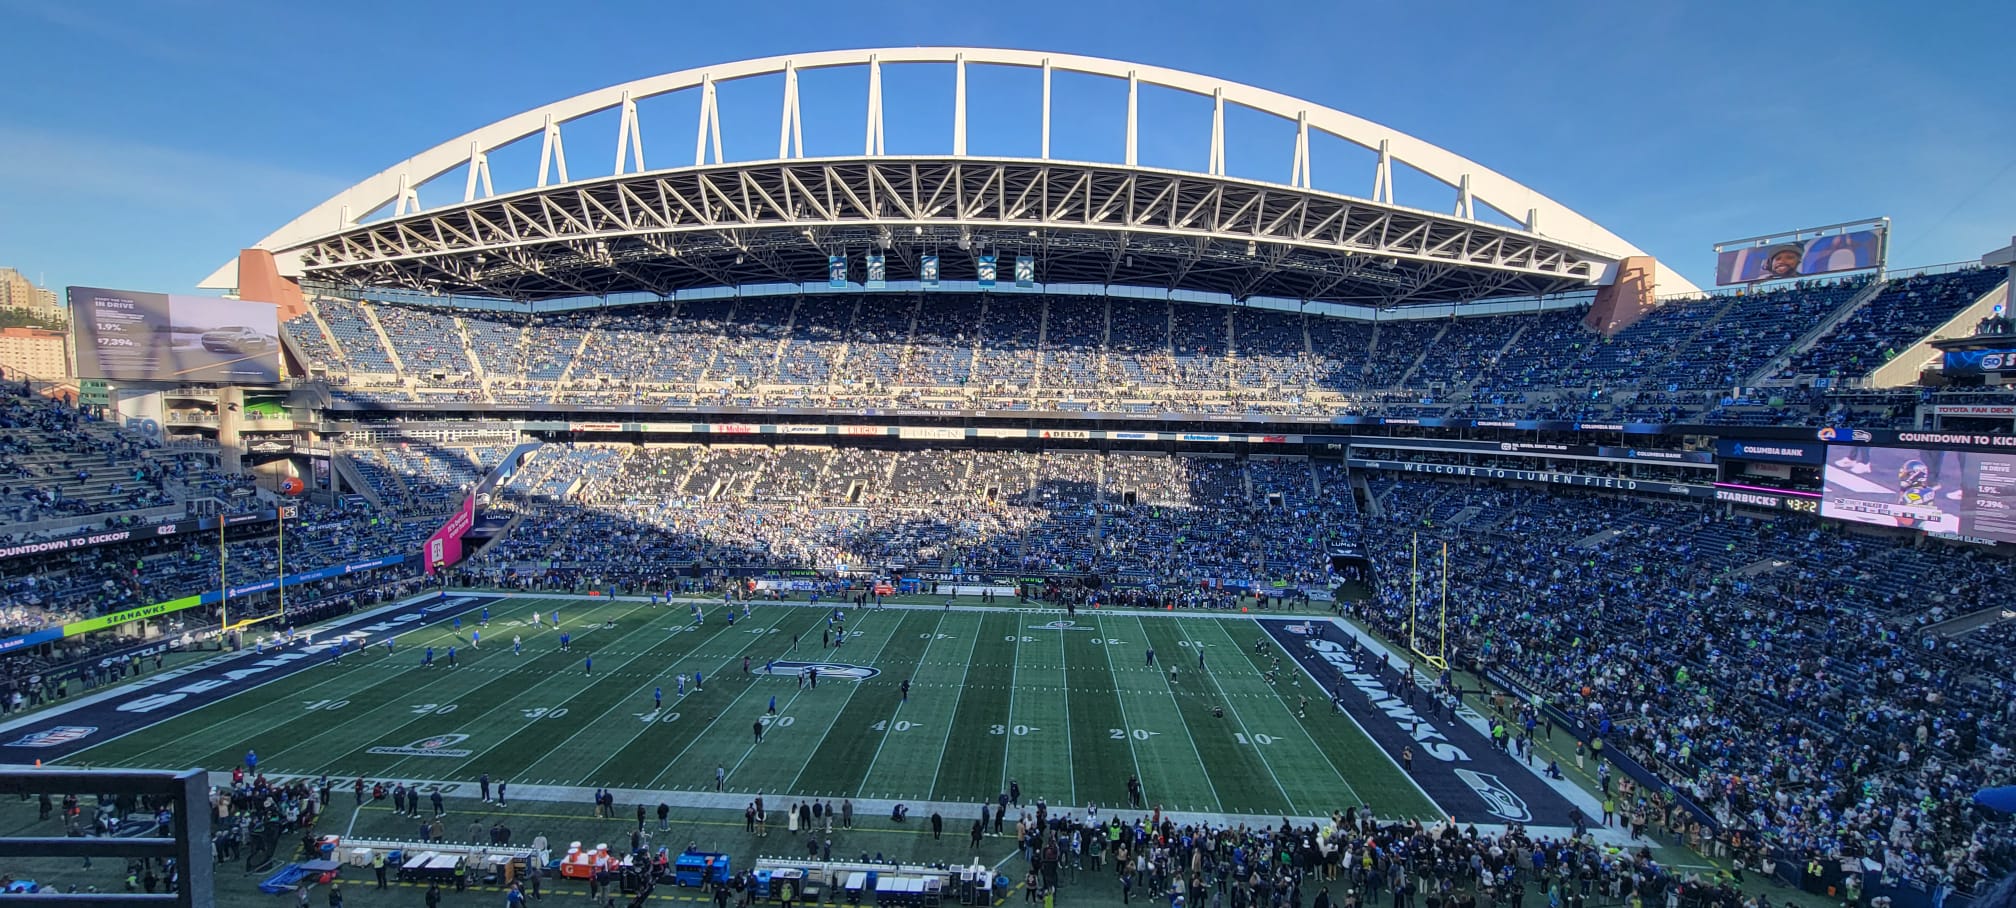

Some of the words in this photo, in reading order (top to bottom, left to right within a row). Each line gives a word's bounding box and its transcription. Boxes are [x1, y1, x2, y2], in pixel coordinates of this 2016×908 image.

[831, 269, 846, 281] 45
[107, 301, 134, 309] DRIVE
[1898, 432, 1971, 445] COUNTDOWN
[1973, 435, 1990, 445] TO
[1744, 446, 1780, 455] COLUMBIA
[1781, 448, 1803, 456] BANK
[1404, 463, 1476, 475] WELCOME
[1487, 468, 1505, 478] TO
[1517, 472, 1572, 484] LUMEN
[1585, 477, 1637, 490] FIELD
[1716, 490, 1777, 507] STARBUCKS
[285, 506, 296, 517] 25
[1786, 499, 1817, 513] 43:22
[71, 538, 86, 547] TO
[88, 531, 130, 545] KICKOFF
[1964, 535, 1998, 547] ELECTRIC
[106, 604, 166, 625] SEAHAWKS
[1309, 639, 1473, 762] SEAHAWKS
[869, 719, 911, 732] 40
[989, 724, 1029, 737] 30
[1109, 728, 1150, 741] 20
[1233, 731, 1273, 746] 10
[565, 865, 574, 874] G
